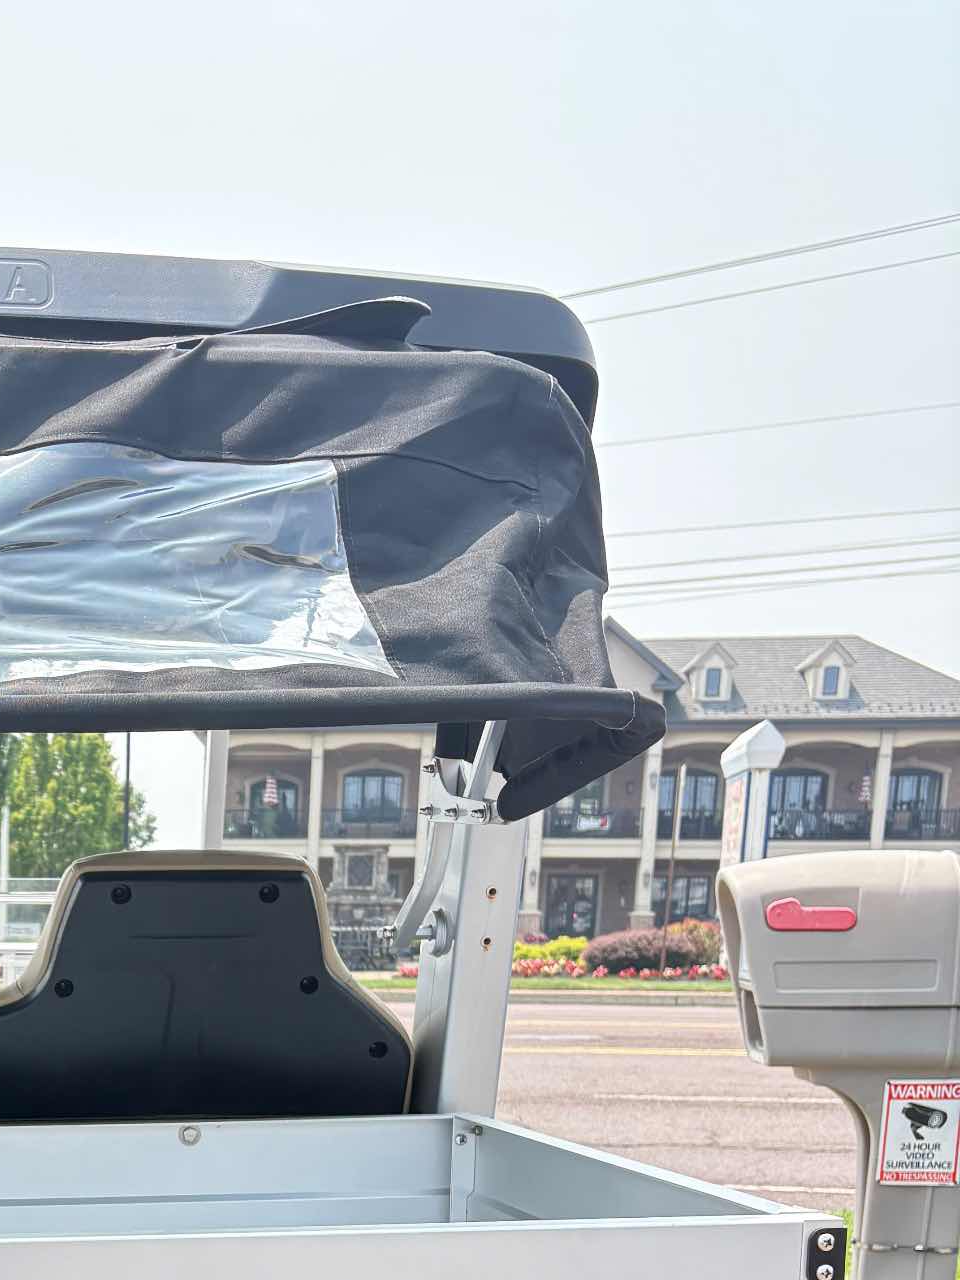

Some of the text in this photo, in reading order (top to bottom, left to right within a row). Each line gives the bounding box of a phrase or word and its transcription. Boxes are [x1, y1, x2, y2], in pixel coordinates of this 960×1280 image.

[891, 1084, 960, 1099] WARNING
[900, 1142, 941, 1151] 24 HOUR
[905, 1151, 935, 1160] VIDEO
[886, 1161, 952, 1170] SURVEILLANCE
[883, 1172, 953, 1182] NO TRESPASSING
